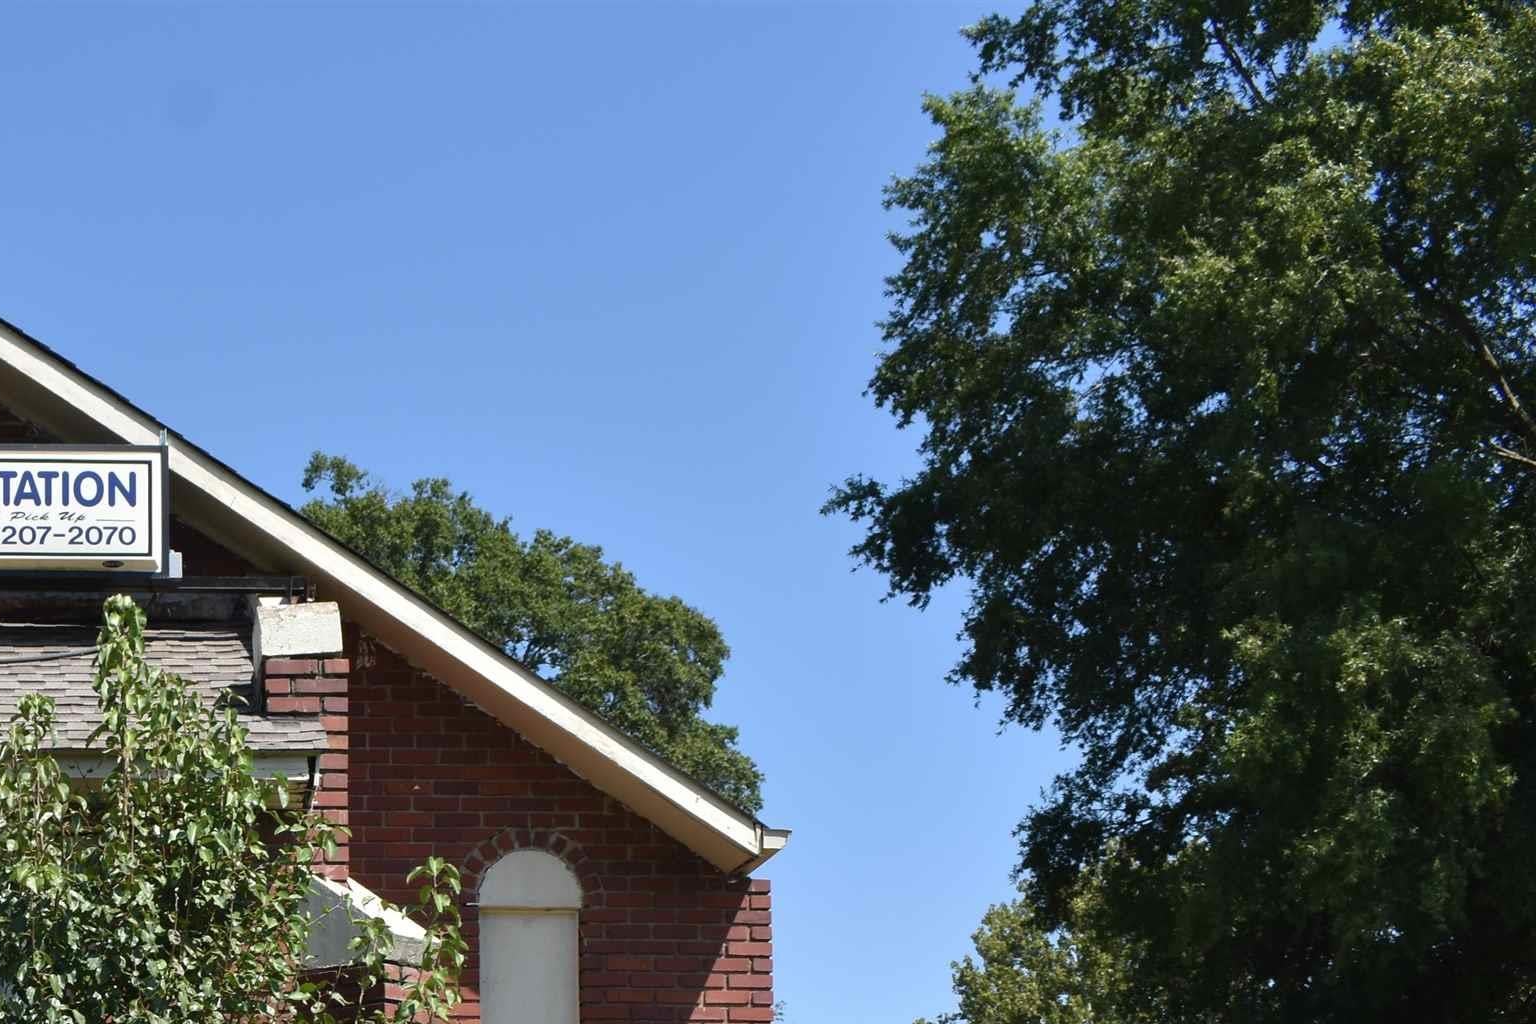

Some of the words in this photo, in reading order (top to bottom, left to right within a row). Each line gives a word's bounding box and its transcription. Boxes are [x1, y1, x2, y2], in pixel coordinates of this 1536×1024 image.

[11, 511, 49, 521] Pick
[58, 512, 86, 522] Up
[1, 526, 137, 546] 207-2070
